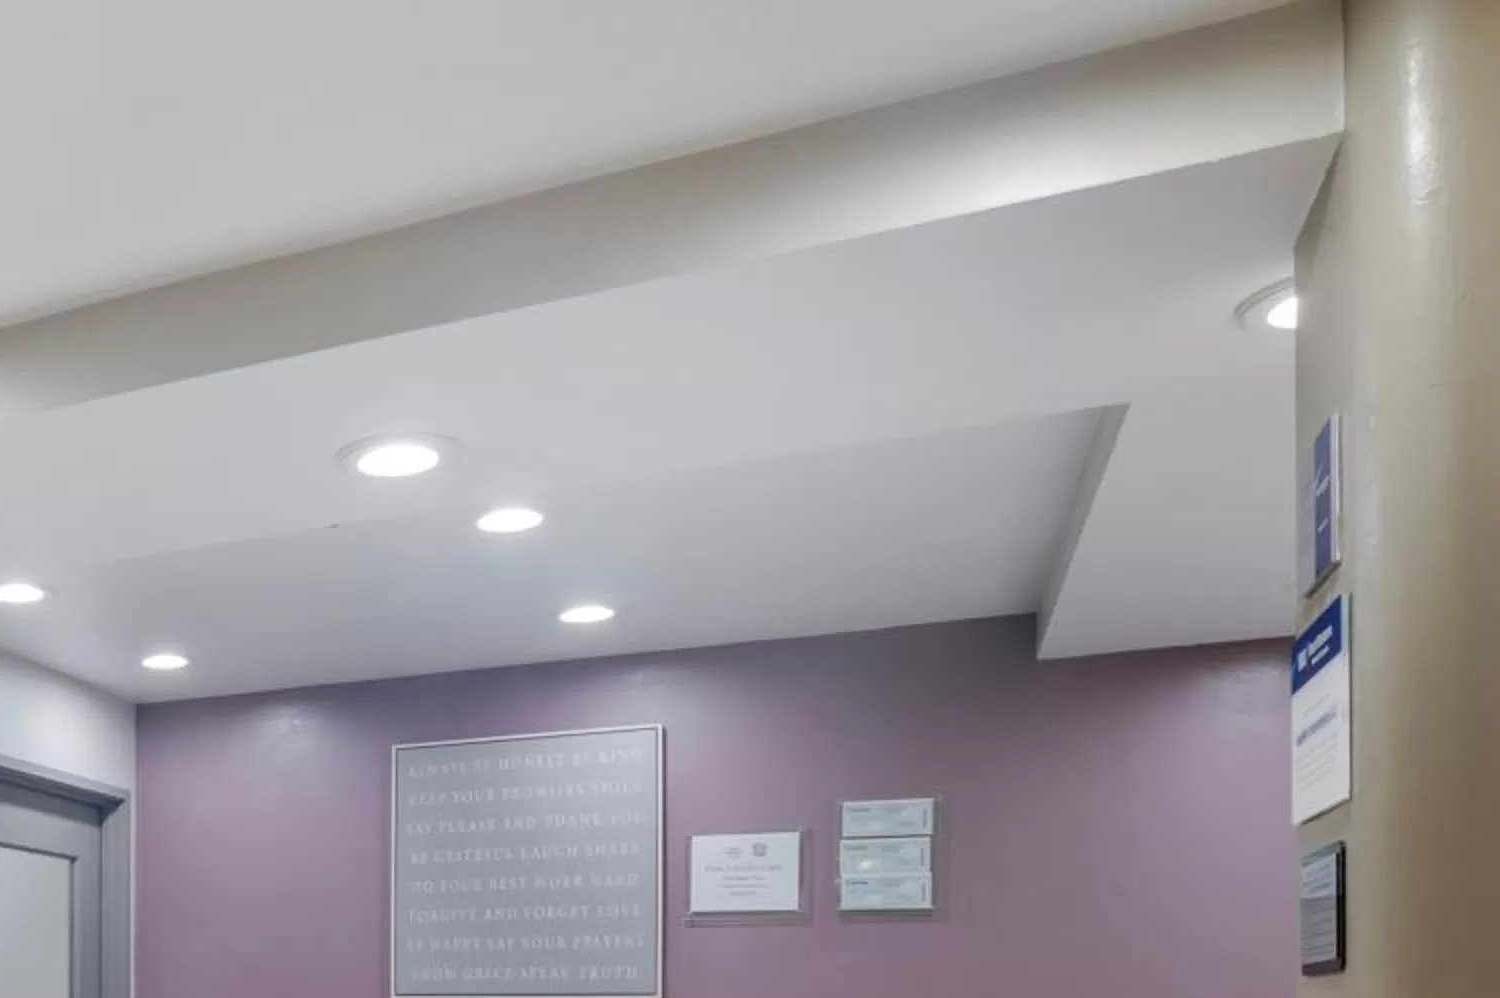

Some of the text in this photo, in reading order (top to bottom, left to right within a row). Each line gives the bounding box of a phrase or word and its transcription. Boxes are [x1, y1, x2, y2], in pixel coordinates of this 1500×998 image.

[503, 815, 536, 830] AND
[489, 876, 527, 891] BEST
[483, 907, 517, 920] AND
[524, 905, 591, 920] FORGET
[579, 964, 638, 981] TRUTH
